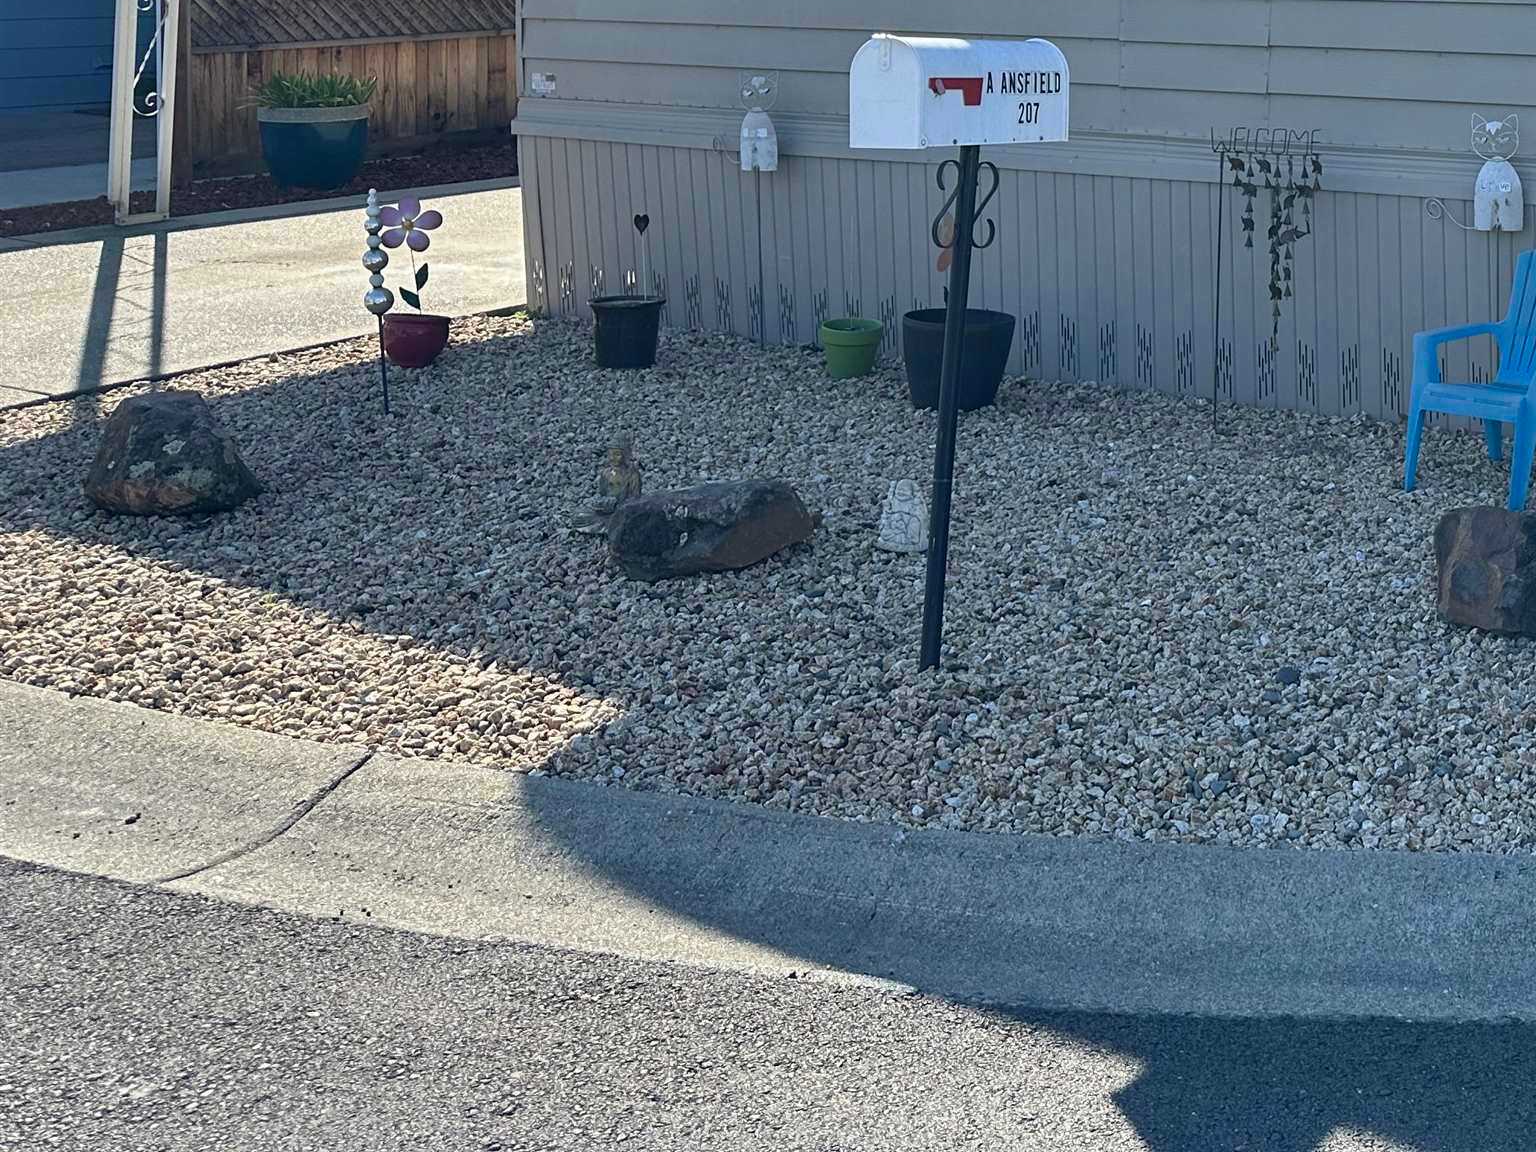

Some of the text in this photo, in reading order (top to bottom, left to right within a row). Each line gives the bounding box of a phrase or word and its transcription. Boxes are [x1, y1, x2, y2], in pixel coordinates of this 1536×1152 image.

[986, 71, 1062, 95] A ANSFIELD
[1017, 102, 1040, 125] 207
[1210, 126, 1321, 156] WELCOME
